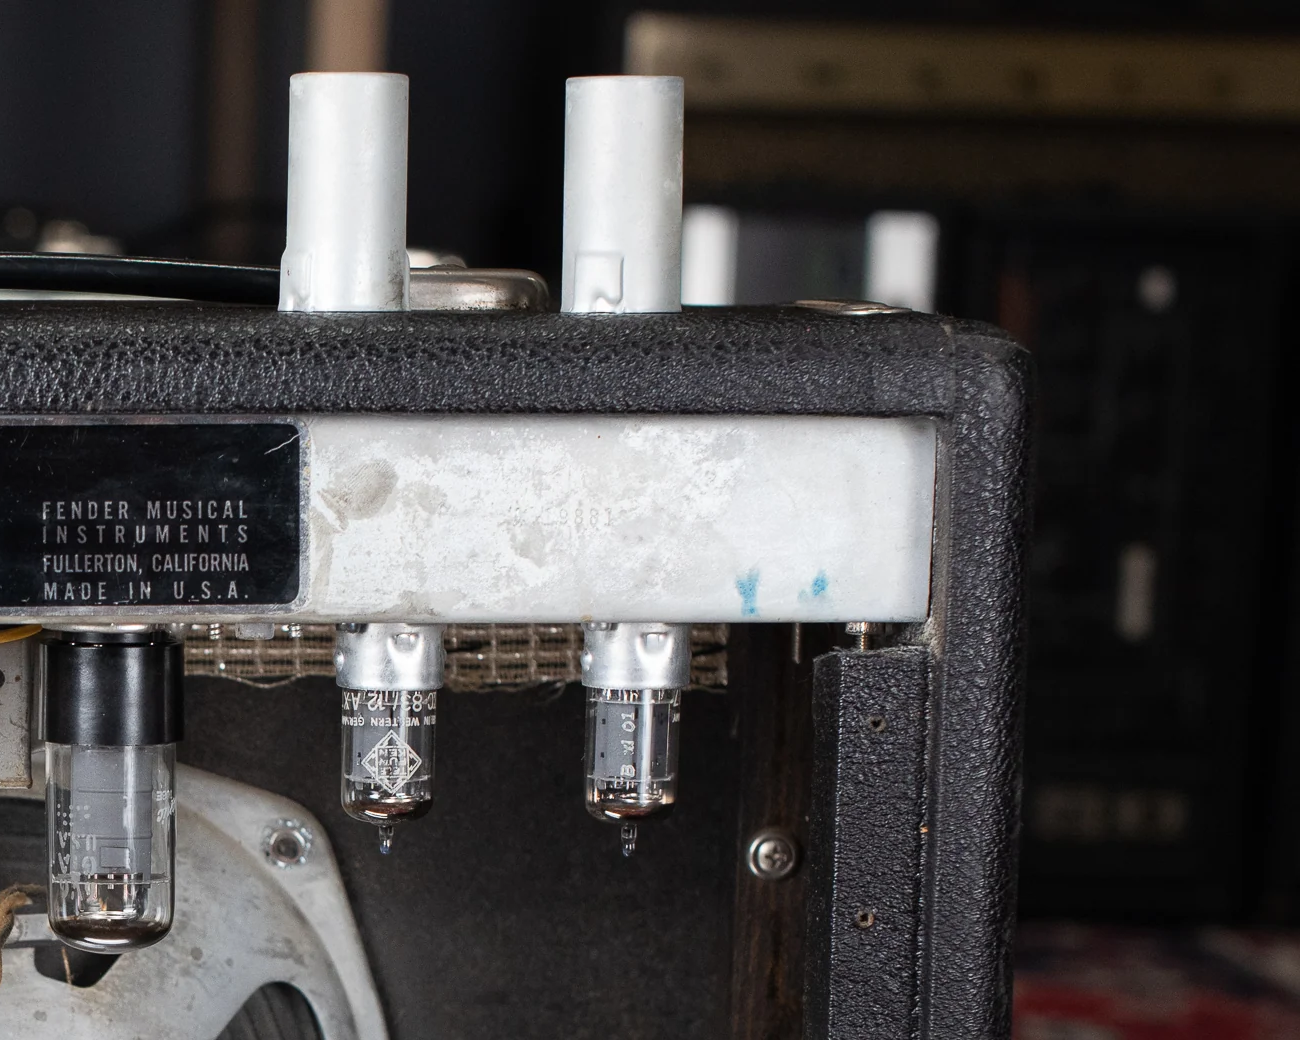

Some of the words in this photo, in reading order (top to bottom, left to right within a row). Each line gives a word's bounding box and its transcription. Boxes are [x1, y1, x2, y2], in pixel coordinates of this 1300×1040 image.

[41, 501, 129, 520] FENDER
[146, 500, 249, 520] MUSICAL
[41, 524, 249, 545] INSTRUMENTS
[42, 554, 144, 576] FULLERTON,
[151, 553, 250, 573] CALIFORNIA
[43, 581, 108, 601] MADE
[128, 582, 152, 601] IN
[173, 580, 250, 601] U.S.A.
[369, 716, 420, 727] WESTERN
